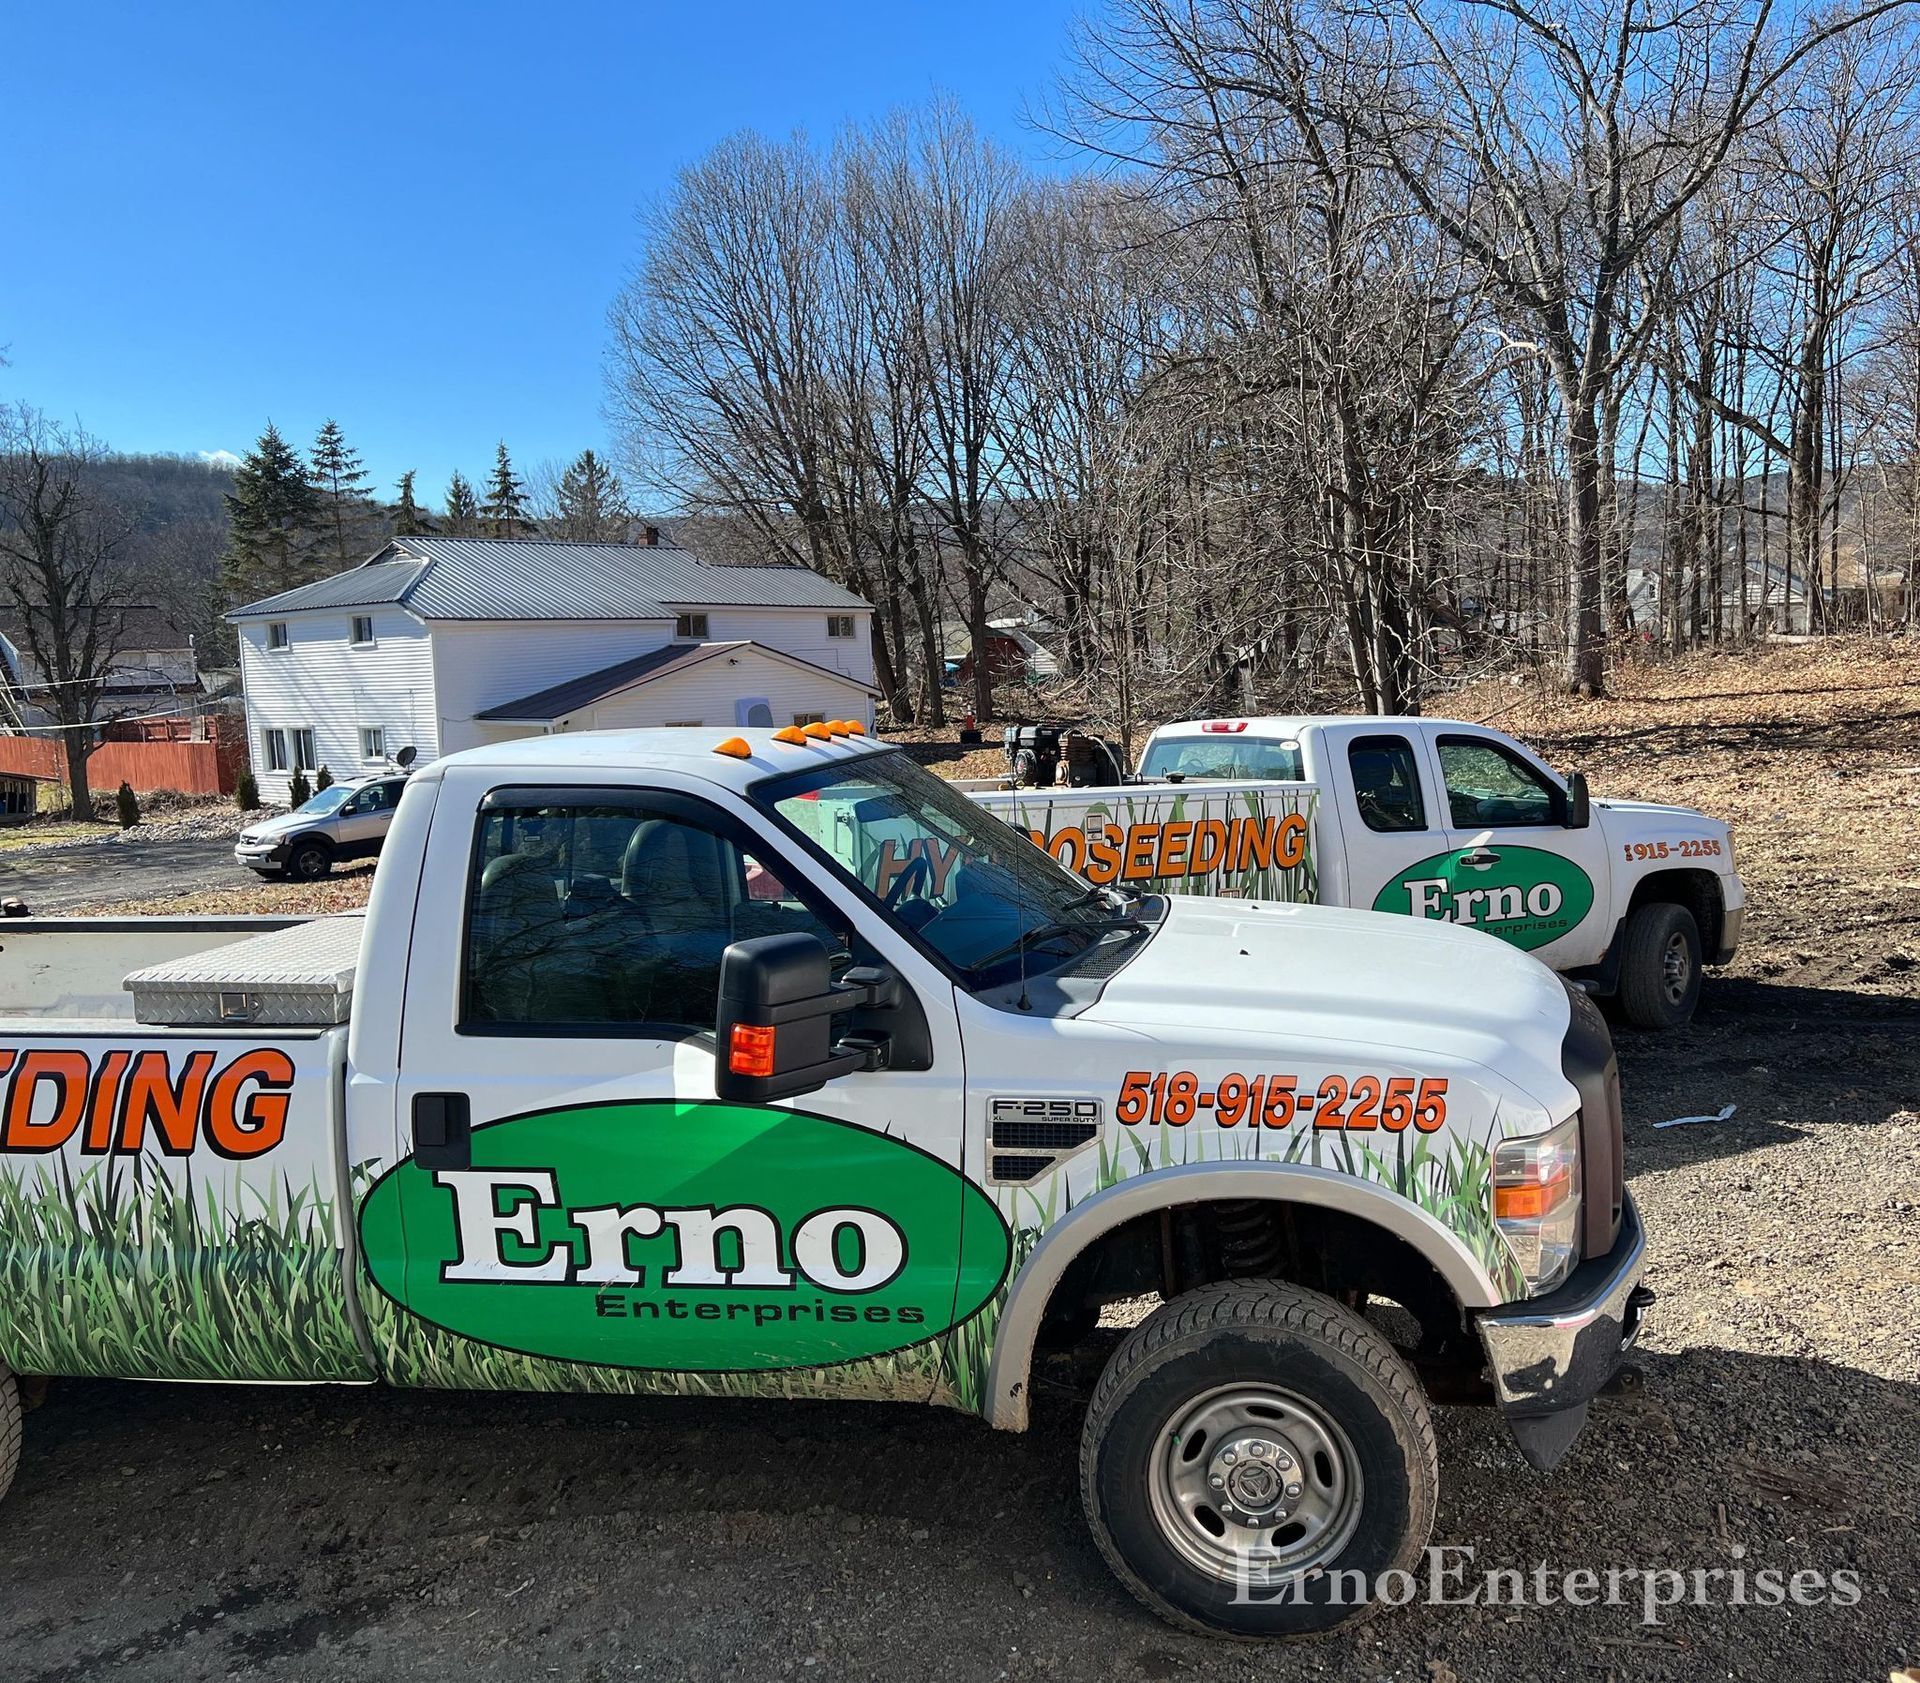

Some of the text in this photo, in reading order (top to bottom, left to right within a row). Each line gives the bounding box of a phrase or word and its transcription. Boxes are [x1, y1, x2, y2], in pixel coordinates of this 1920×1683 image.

[1403, 877, 1564, 926] Erno
[992, 1100, 1097, 1116] F-250
[1116, 1070, 1449, 1133] 518-915-2255
[433, 1167, 909, 1295] Erno
[595, 1293, 926, 1328] Enterprises
